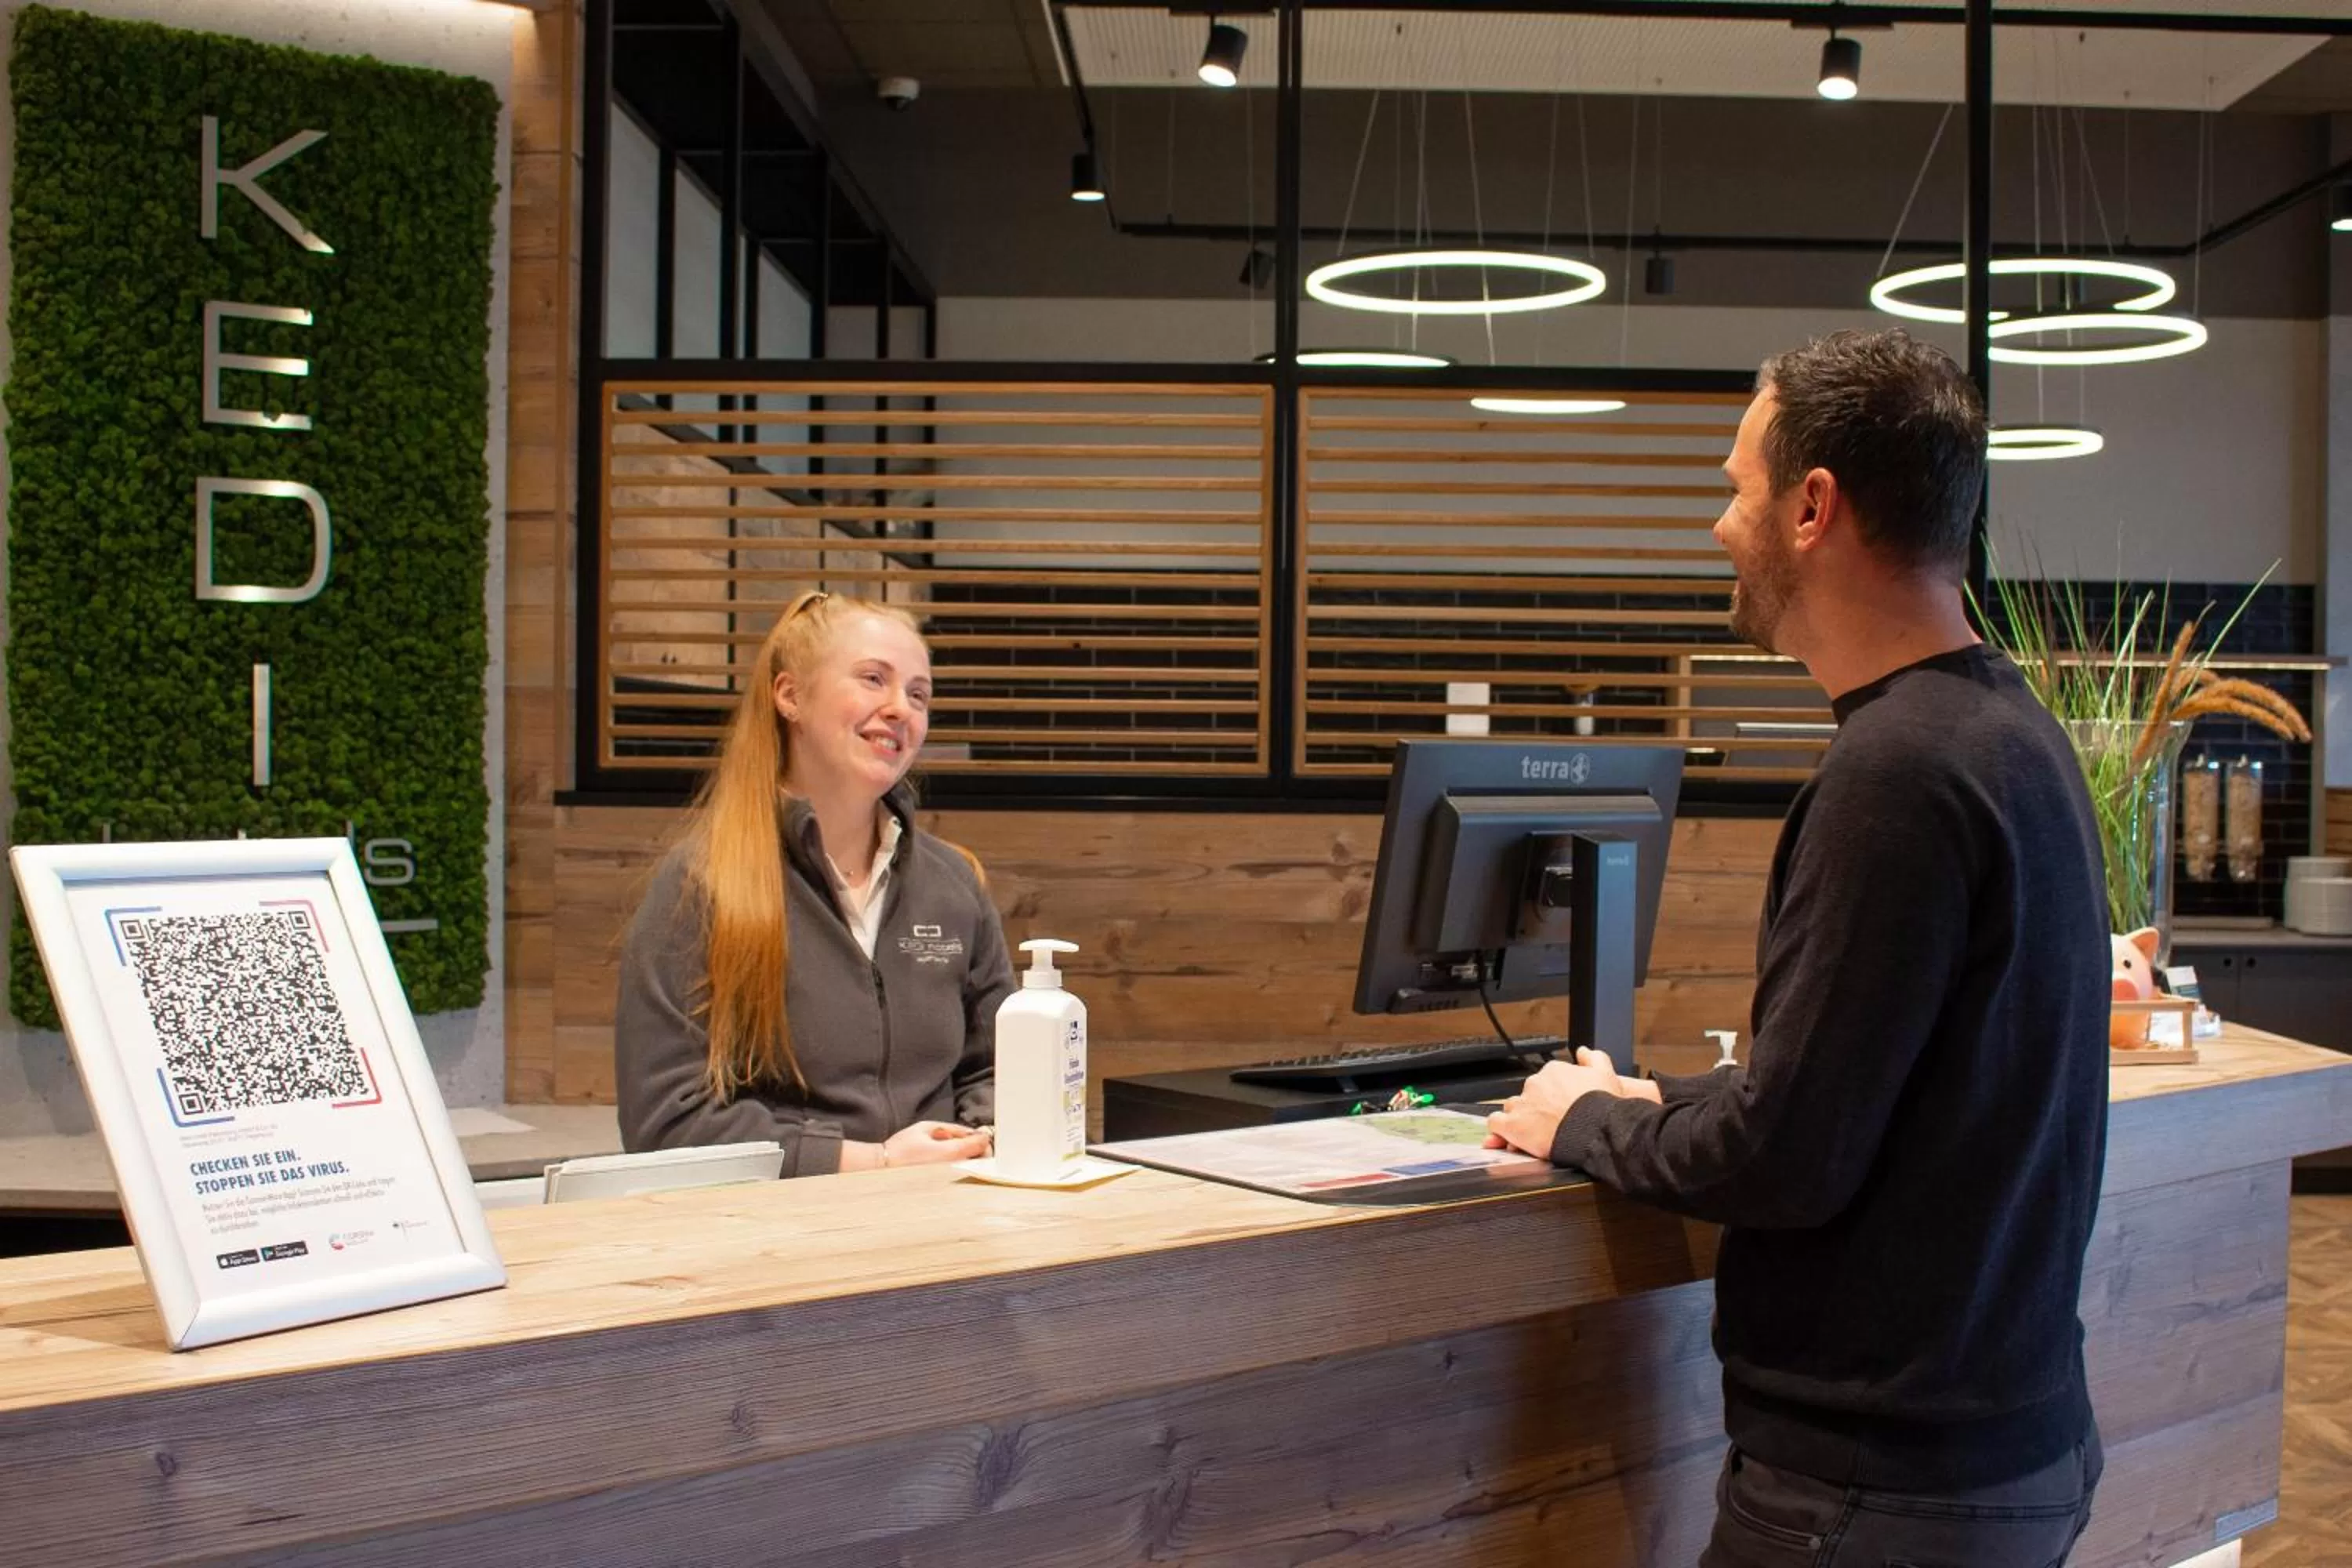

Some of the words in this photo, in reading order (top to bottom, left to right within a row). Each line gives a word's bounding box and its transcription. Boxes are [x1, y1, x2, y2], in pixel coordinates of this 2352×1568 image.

[195, 114, 335, 786] KEDI
[1521, 756, 1568, 779] terra
[190, 1156, 249, 1176] CHECKEN
[253, 1153, 272, 1167] SIE
[275, 1149, 302, 1164] EIN.
[195, 1174, 255, 1195] STOPPEN
[257, 1171, 278, 1185] SIE
[281, 1167, 306, 1182] DAS
[307, 1160, 350, 1178] VIRUS.
